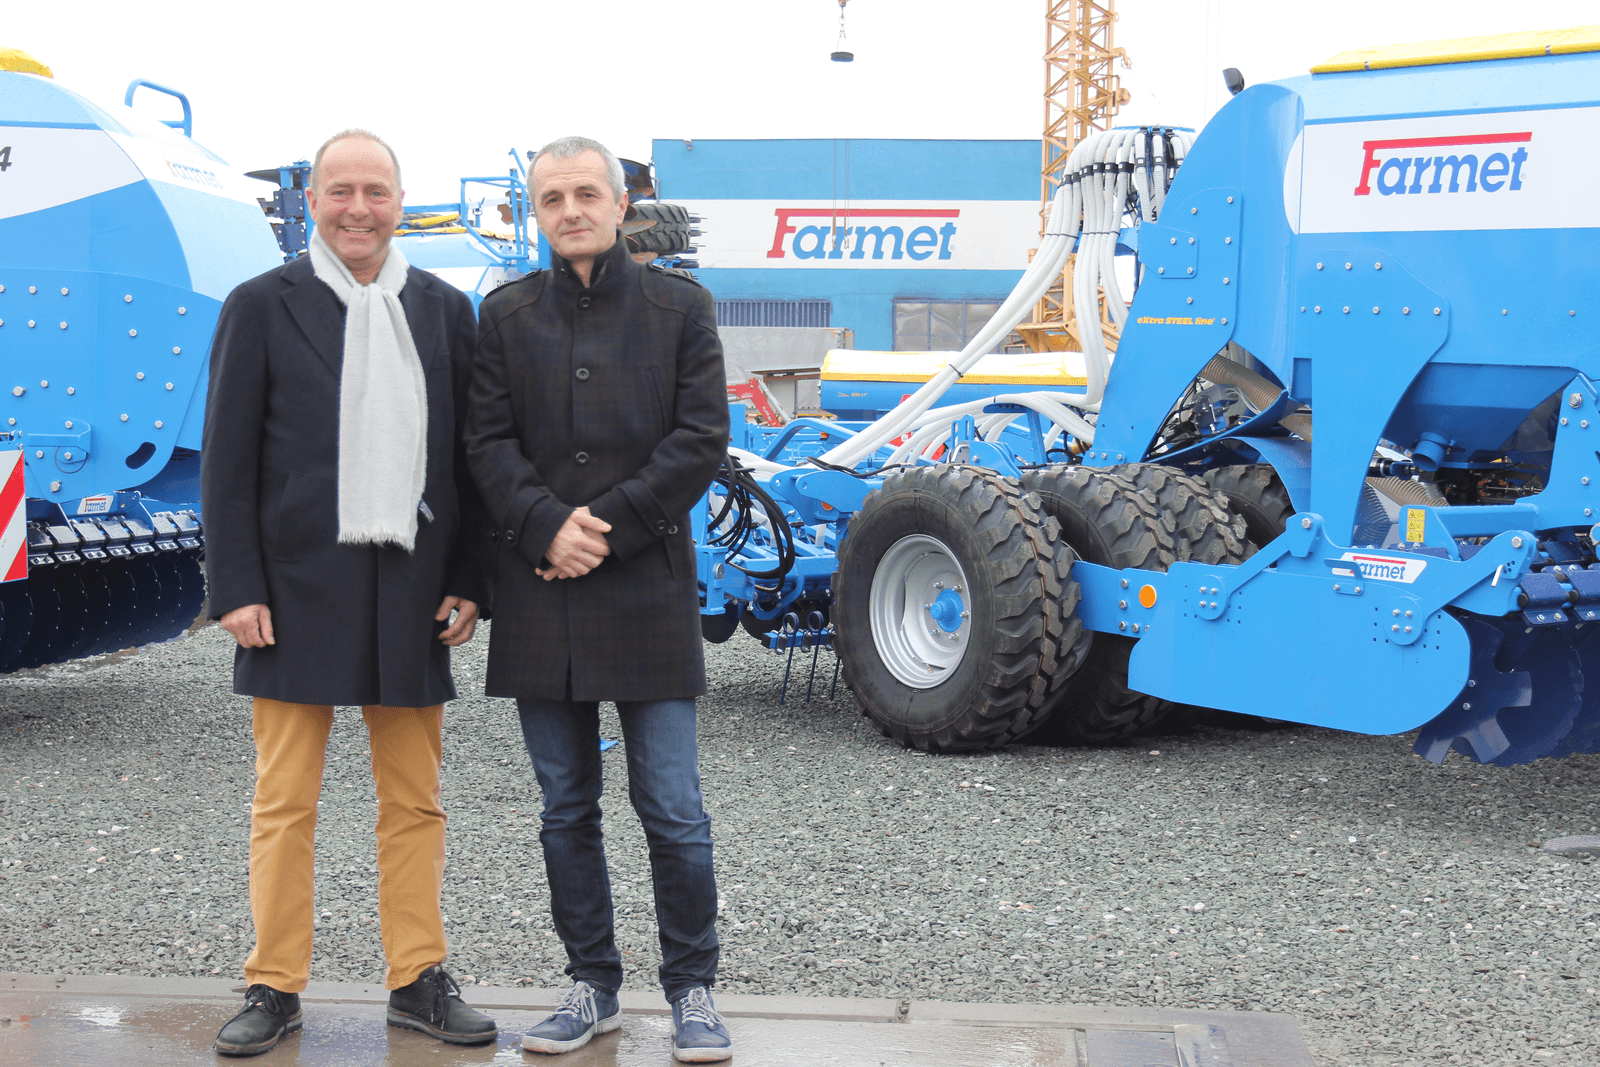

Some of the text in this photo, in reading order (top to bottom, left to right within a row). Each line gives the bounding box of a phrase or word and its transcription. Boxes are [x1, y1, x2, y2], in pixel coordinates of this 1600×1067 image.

[0, 146, 12, 172] 4
[1354, 132, 1532, 196] Farmet
[766, 208, 960, 261] Farmet
[1137, 316, 1164, 324] eXtra
[1165, 317, 1194, 325] STEEL
